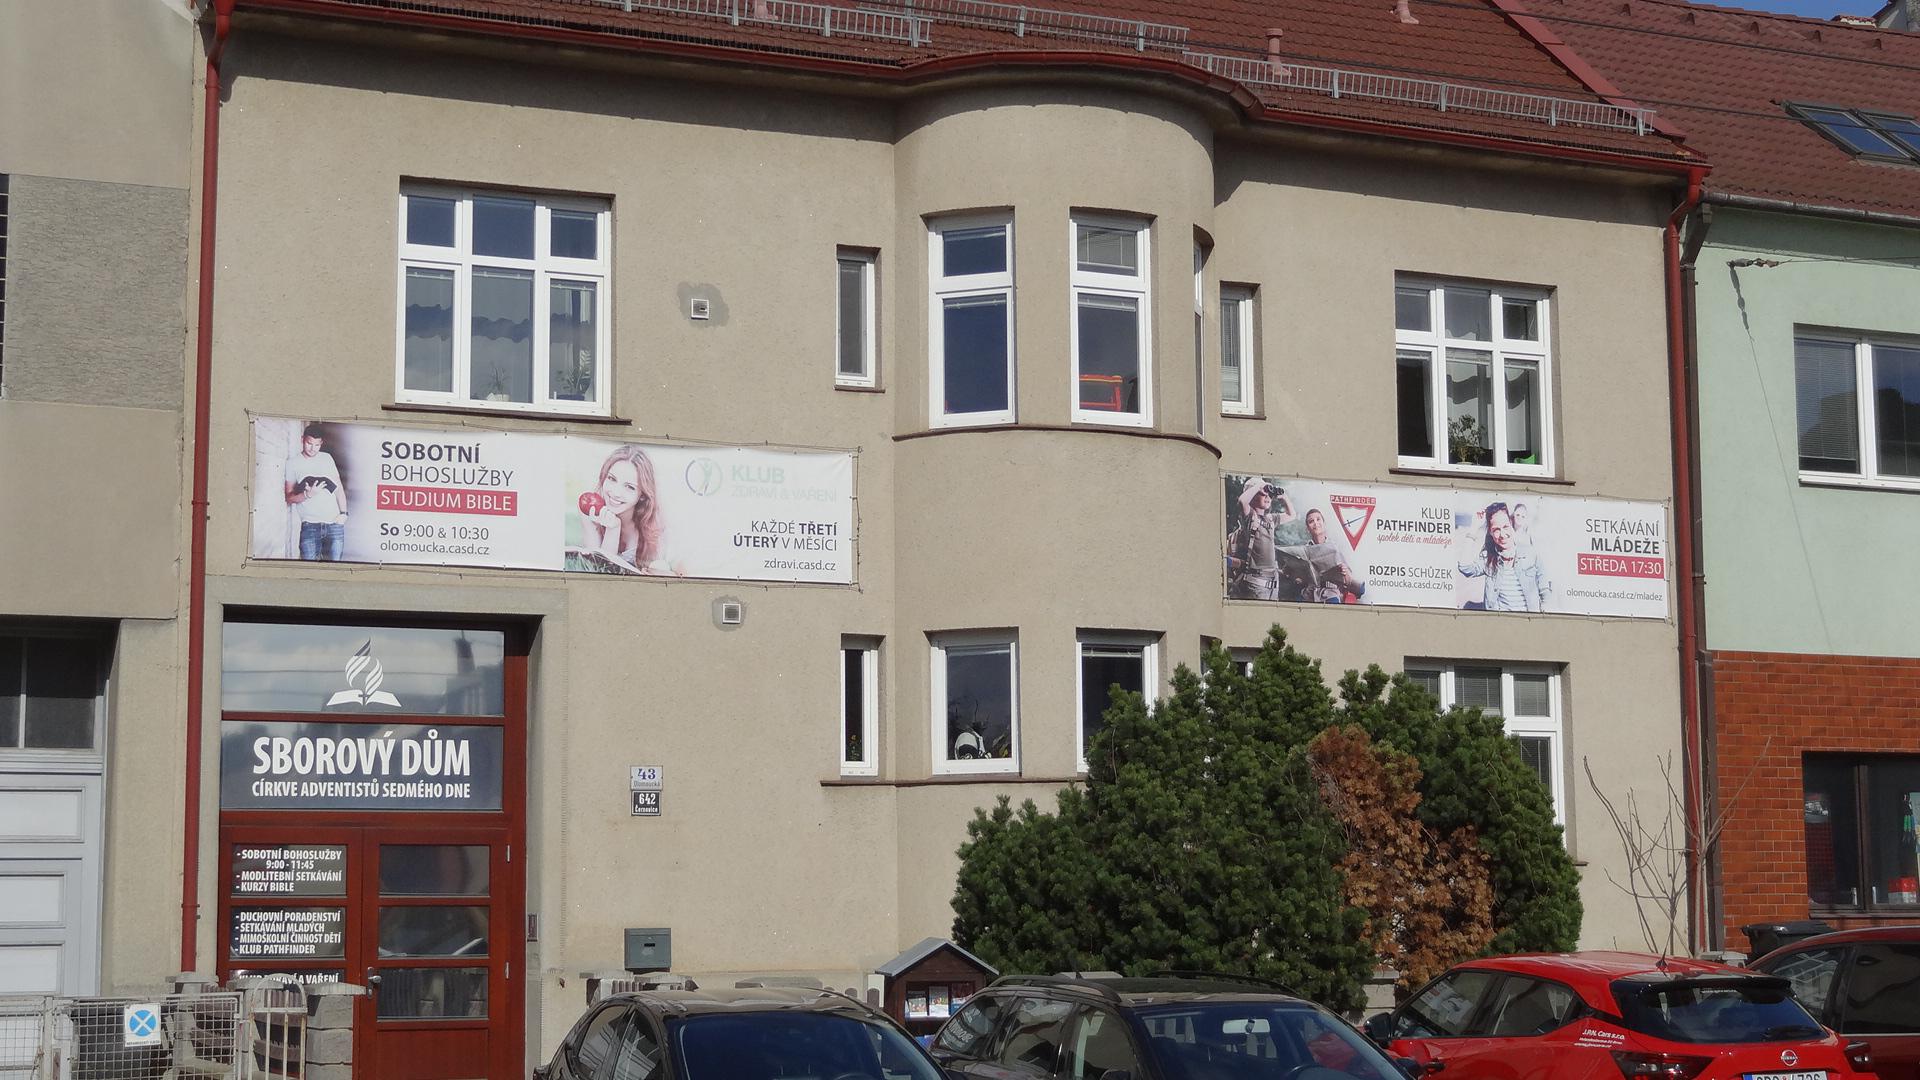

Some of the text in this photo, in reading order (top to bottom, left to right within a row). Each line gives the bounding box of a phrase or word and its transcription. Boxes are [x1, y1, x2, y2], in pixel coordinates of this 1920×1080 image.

[381, 441, 480, 463] SOBOTNÍ
[381, 463, 514, 487] BOHOSLUŽBY
[732, 464, 784, 484] KLUB
[380, 489, 512, 511] STUDIUM BIBLE
[1421, 507, 1451, 520] KLUB
[380, 523, 489, 540] So 9:00 & 10:30
[751, 520, 837, 536] KAŽDÉ TŘETÍ
[1377, 519, 1451, 534] PATHFINDER
[1586, 518, 1660, 537] SETKÁVÁNÍ
[380, 540, 490, 556] olomoucka.casd.cz
[733, 532, 837, 551] ÚTERÝ V MĚSÍCI
[1591, 536, 1660, 555] MLÁDEŽE
[764, 558, 836, 571] zdravi.casd.cz
[1580, 555, 1661, 575] STŘEDA 17:30
[1369, 565, 1453, 580] ROZPIS SCHŮZEK
[1369, 578, 1453, 591] olomoucka.casd.cz/kp
[1566, 588, 1663, 602] olomoucka.casd.cz/mladez
[253, 728, 471, 776] SBOROVÝ DŮM
[252, 778, 471, 798] CÍRKVE ADVENTISTŮ SEDMÉHO DNE
[639, 793, 656, 805] 642
[242, 848, 282, 860] SOBOTNÍ
[283, 849, 342, 860] BOHOSLUŽBY
[266, 860, 284, 869] 9:00
[291, 860, 314, 870] 11:45
[241, 870, 295, 881] MODLITEBNÍ
[296, 870, 342, 882] SETKÁVÁNÍ
[241, 882, 268, 892] KURZY
[270, 882, 294, 892] BIBLE
[240, 910, 284, 922] DUCHOVNÍ
[285, 911, 341, 922] PORADENSTVÍ
[240, 921, 285, 932] SETKÁVÁNÍ
[286, 921, 325, 932] MLADÝCH
[239, 931, 290, 943] MIMOŠKOLNÍ
[290, 931, 323, 943] ČINNOST
[324, 932, 341, 943] DĚTÍ
[239, 945, 262, 954] KLUB
[263, 944, 316, 954] PATHFINDER
